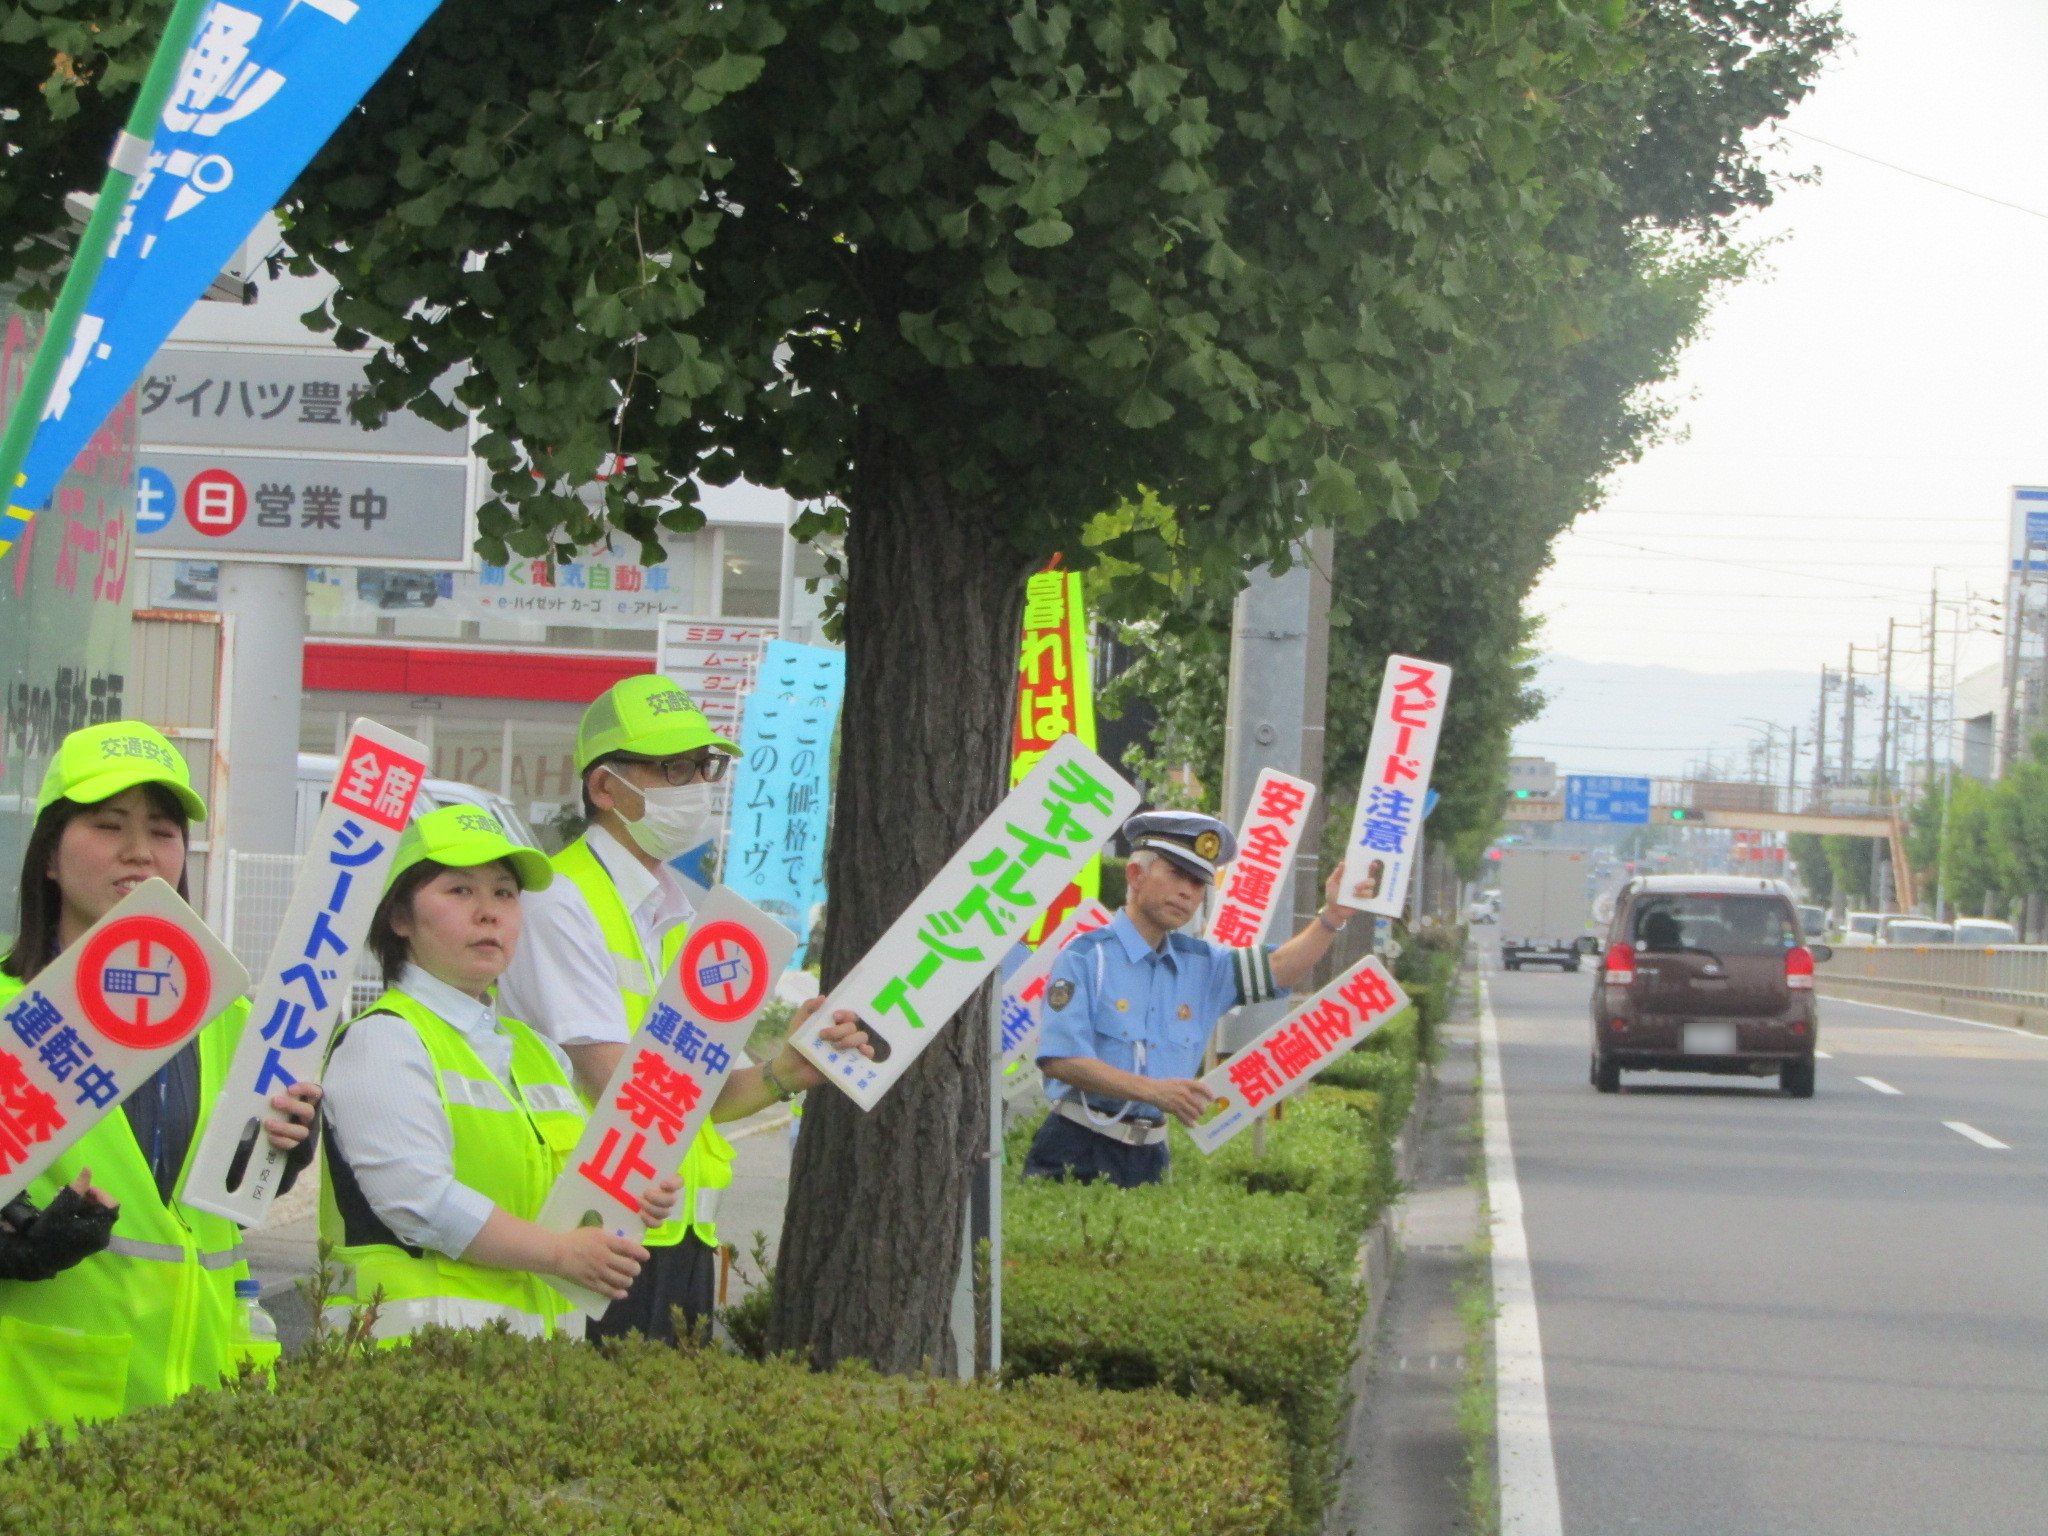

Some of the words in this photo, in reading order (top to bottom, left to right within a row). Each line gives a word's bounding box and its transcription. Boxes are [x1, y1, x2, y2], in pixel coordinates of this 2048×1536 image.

[198, 482, 234, 524] 日
[255, 483, 387, 531] 営業中
[101, 736, 176, 773] 交通安全
[345, 751, 414, 822] 全席
[870, 757, 1115, 1030] チャイルドシート
[1212, 778, 1306, 948] 安全運転
[253, 818, 385, 1098] シートベルト
[3, 990, 121, 1110] 運転中
[645, 1001, 731, 1076] 運転中
[1228, 966, 1397, 1108] 安全運転
[578, 1048, 702, 1214] 禁止
